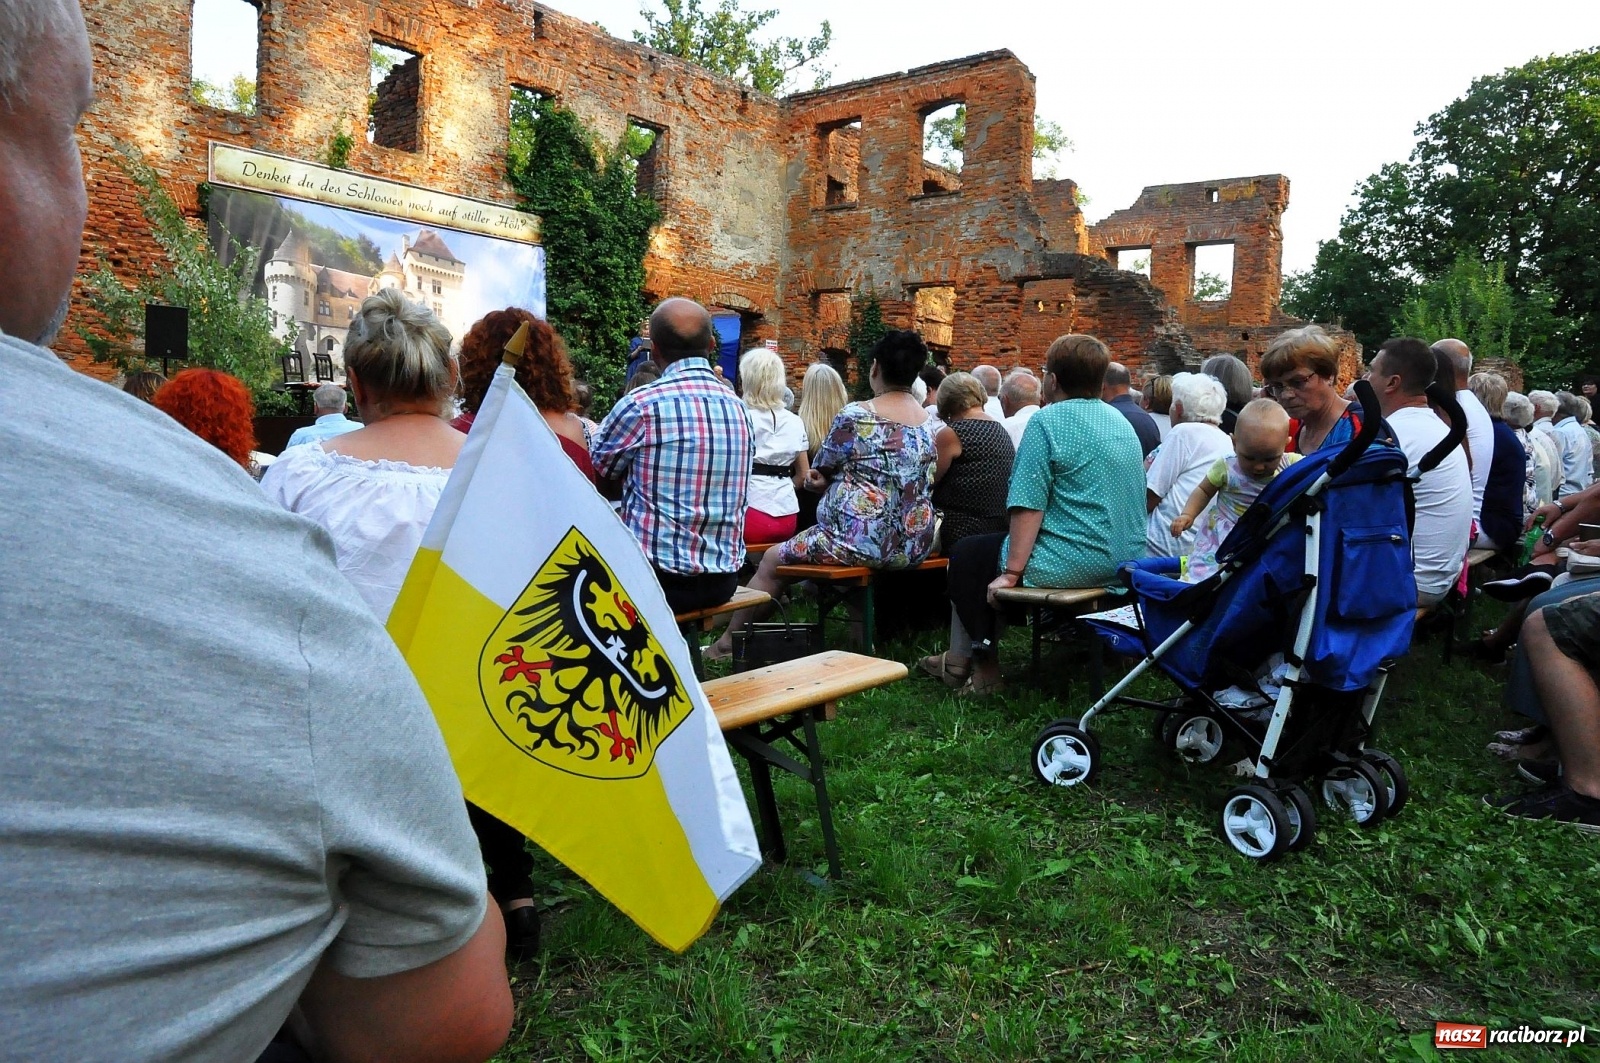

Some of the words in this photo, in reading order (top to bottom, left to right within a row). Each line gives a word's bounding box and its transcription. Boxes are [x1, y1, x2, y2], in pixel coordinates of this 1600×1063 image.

[242, 161, 292, 184] Denkst
[298, 174, 314, 189] du
[320, 178, 341, 194] des
[346, 183, 403, 207] Schlosses
[408, 200, 433, 213] noch
[438, 205, 458, 220] auf
[461, 209, 491, 224] stiller
[494, 214, 527, 231] Höh?
